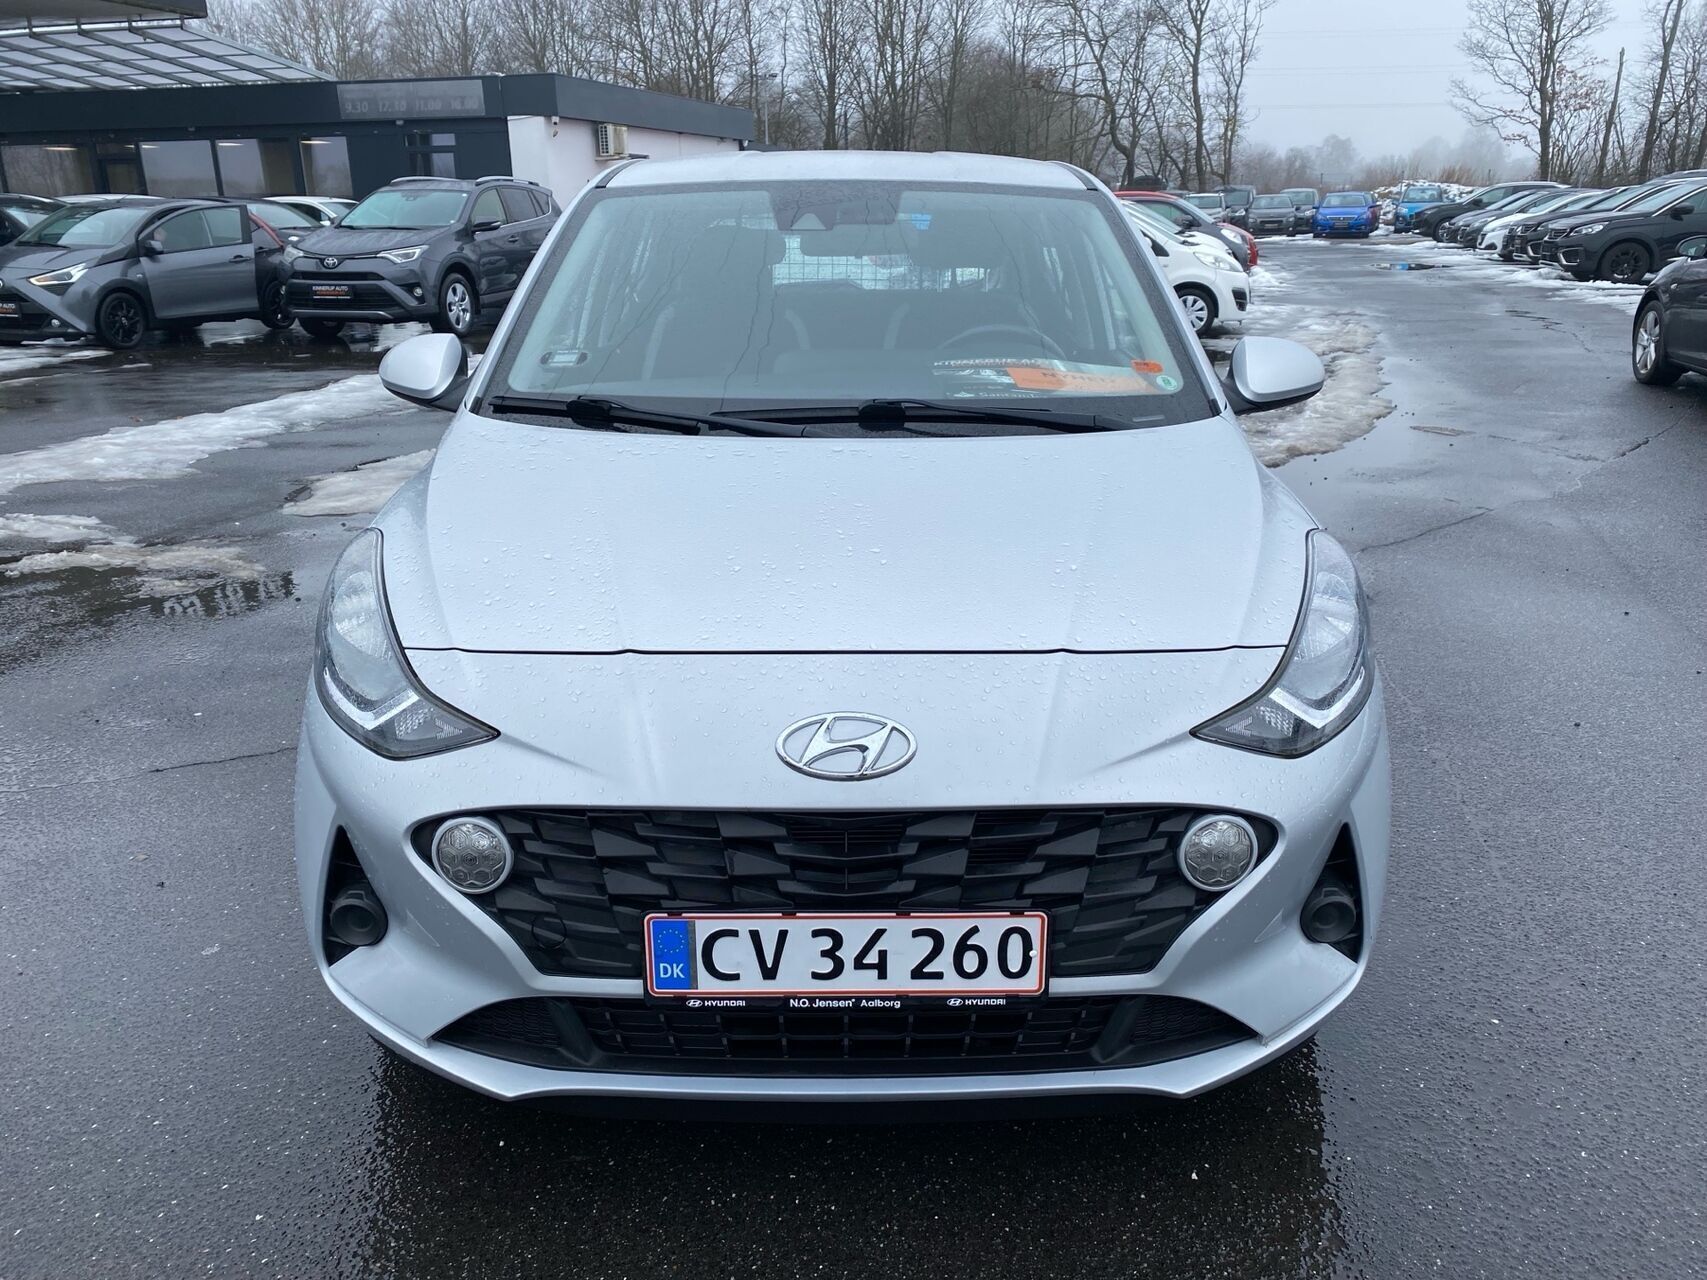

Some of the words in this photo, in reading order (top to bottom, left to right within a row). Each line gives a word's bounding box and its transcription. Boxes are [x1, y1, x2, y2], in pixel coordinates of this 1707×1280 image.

[700, 928, 789, 981] CV
[810, 928, 888, 981] 34
[910, 925, 1034, 980] 260
[659, 963, 685, 979] DK
[789, 999, 811, 1008] N.O.
[860, 999, 901, 1009] Aalborg
[965, 998, 1006, 1006] HYUNDAI
